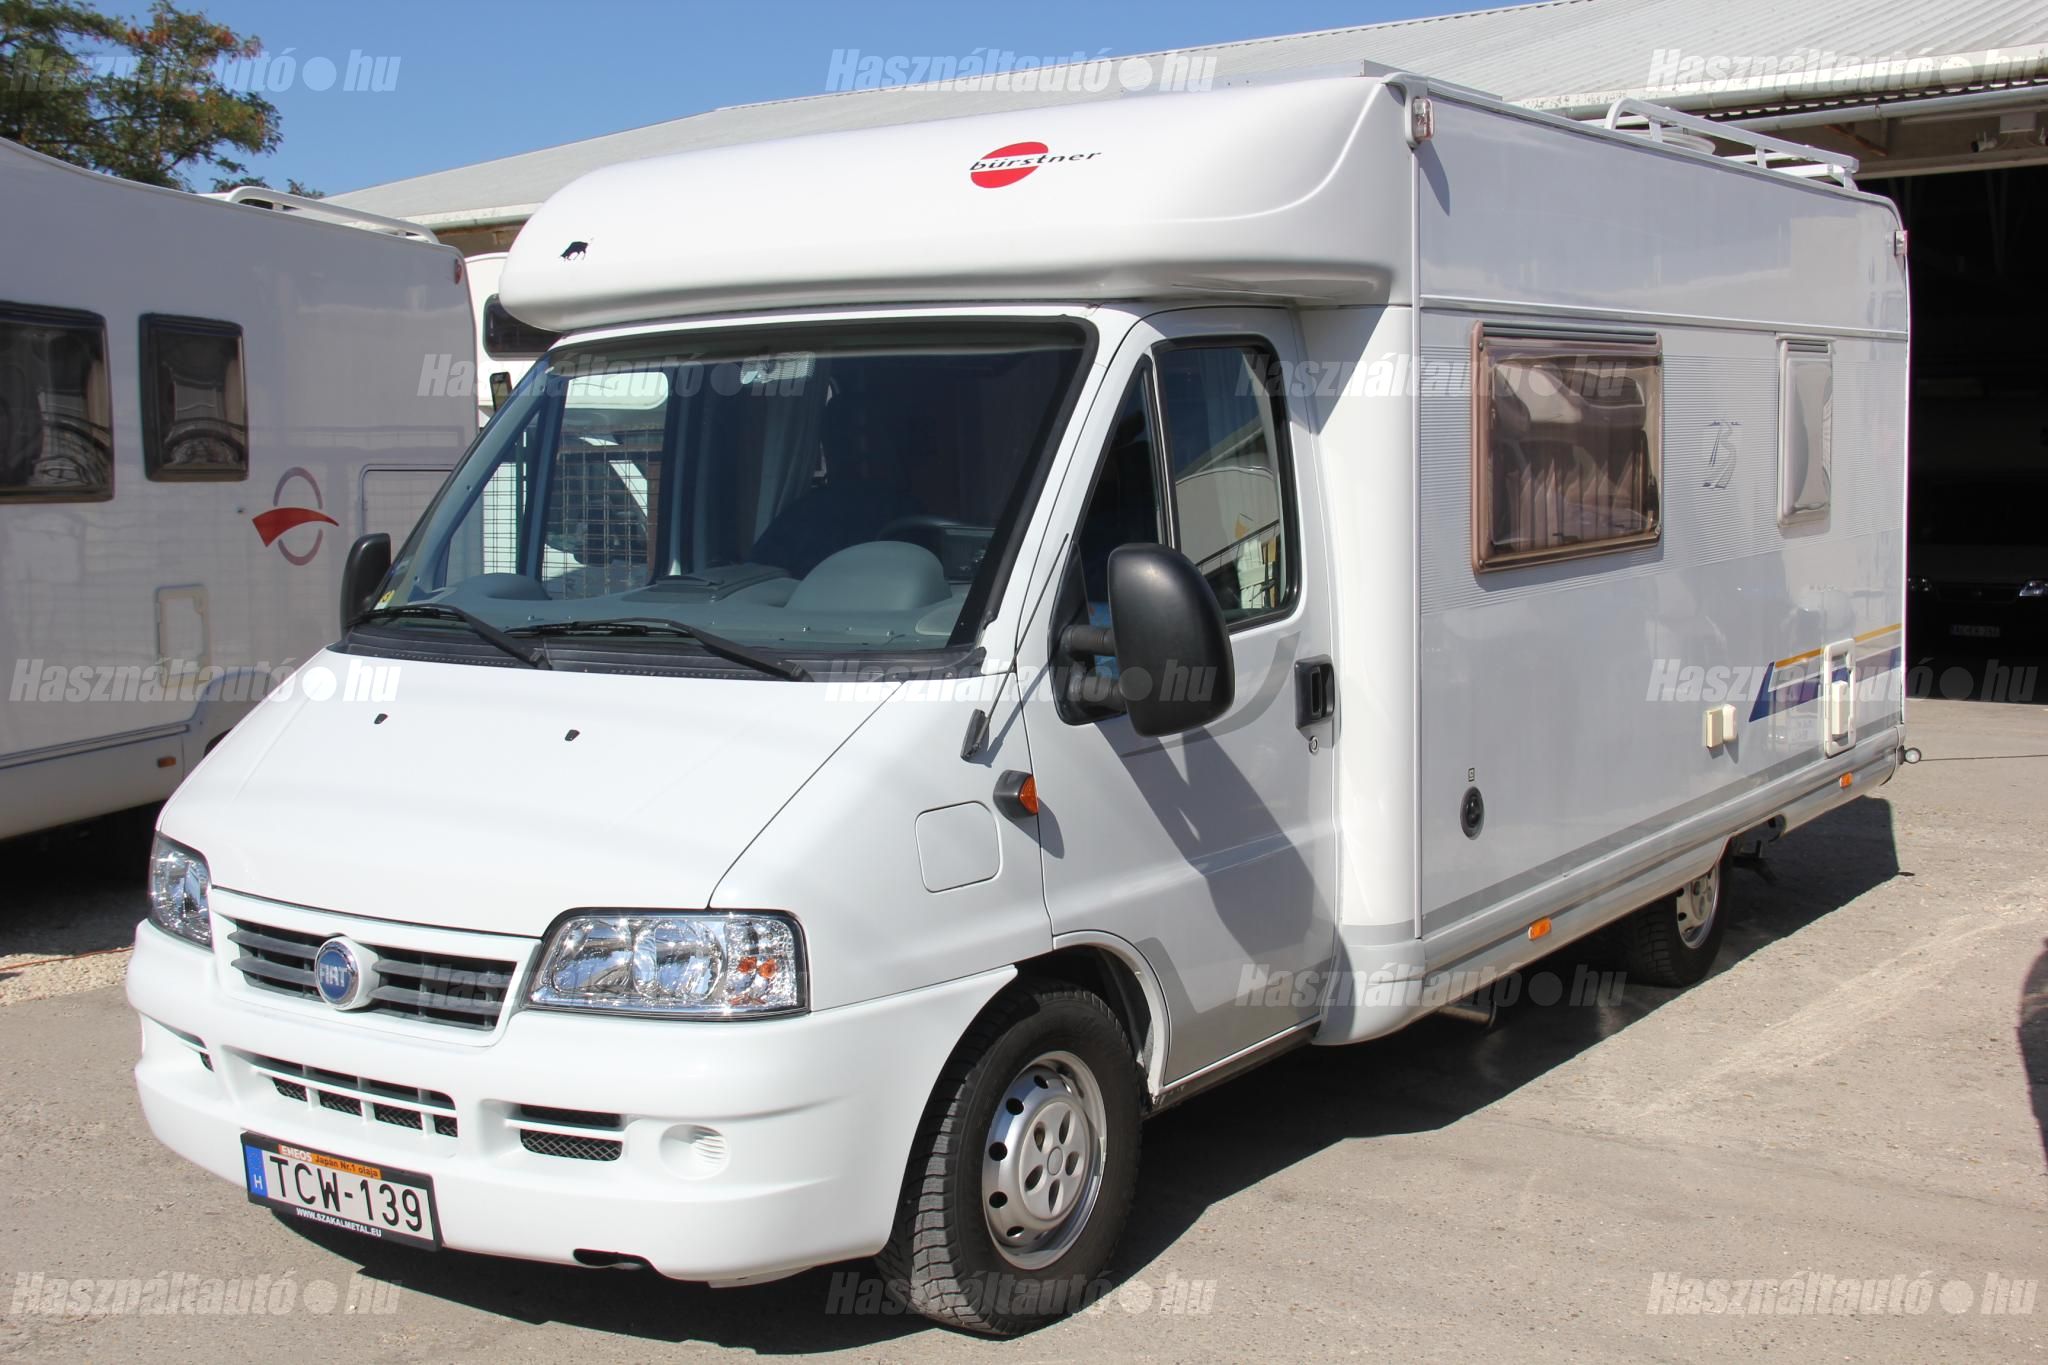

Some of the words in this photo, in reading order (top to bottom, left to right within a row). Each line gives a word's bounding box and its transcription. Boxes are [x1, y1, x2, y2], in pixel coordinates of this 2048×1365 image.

[969, 152, 1102, 171] bürstner
[319, 962, 348, 988] FIAT
[281, 1145, 313, 1163] ENEOS
[315, 1155, 338, 1167] Japan
[340, 1161, 356, 1172] Nr.1
[253, 1174, 264, 1190] H
[269, 1155, 423, 1232] TCW-139
[296, 1208, 382, 1238] WWW.SZAKALMETAL.EU
